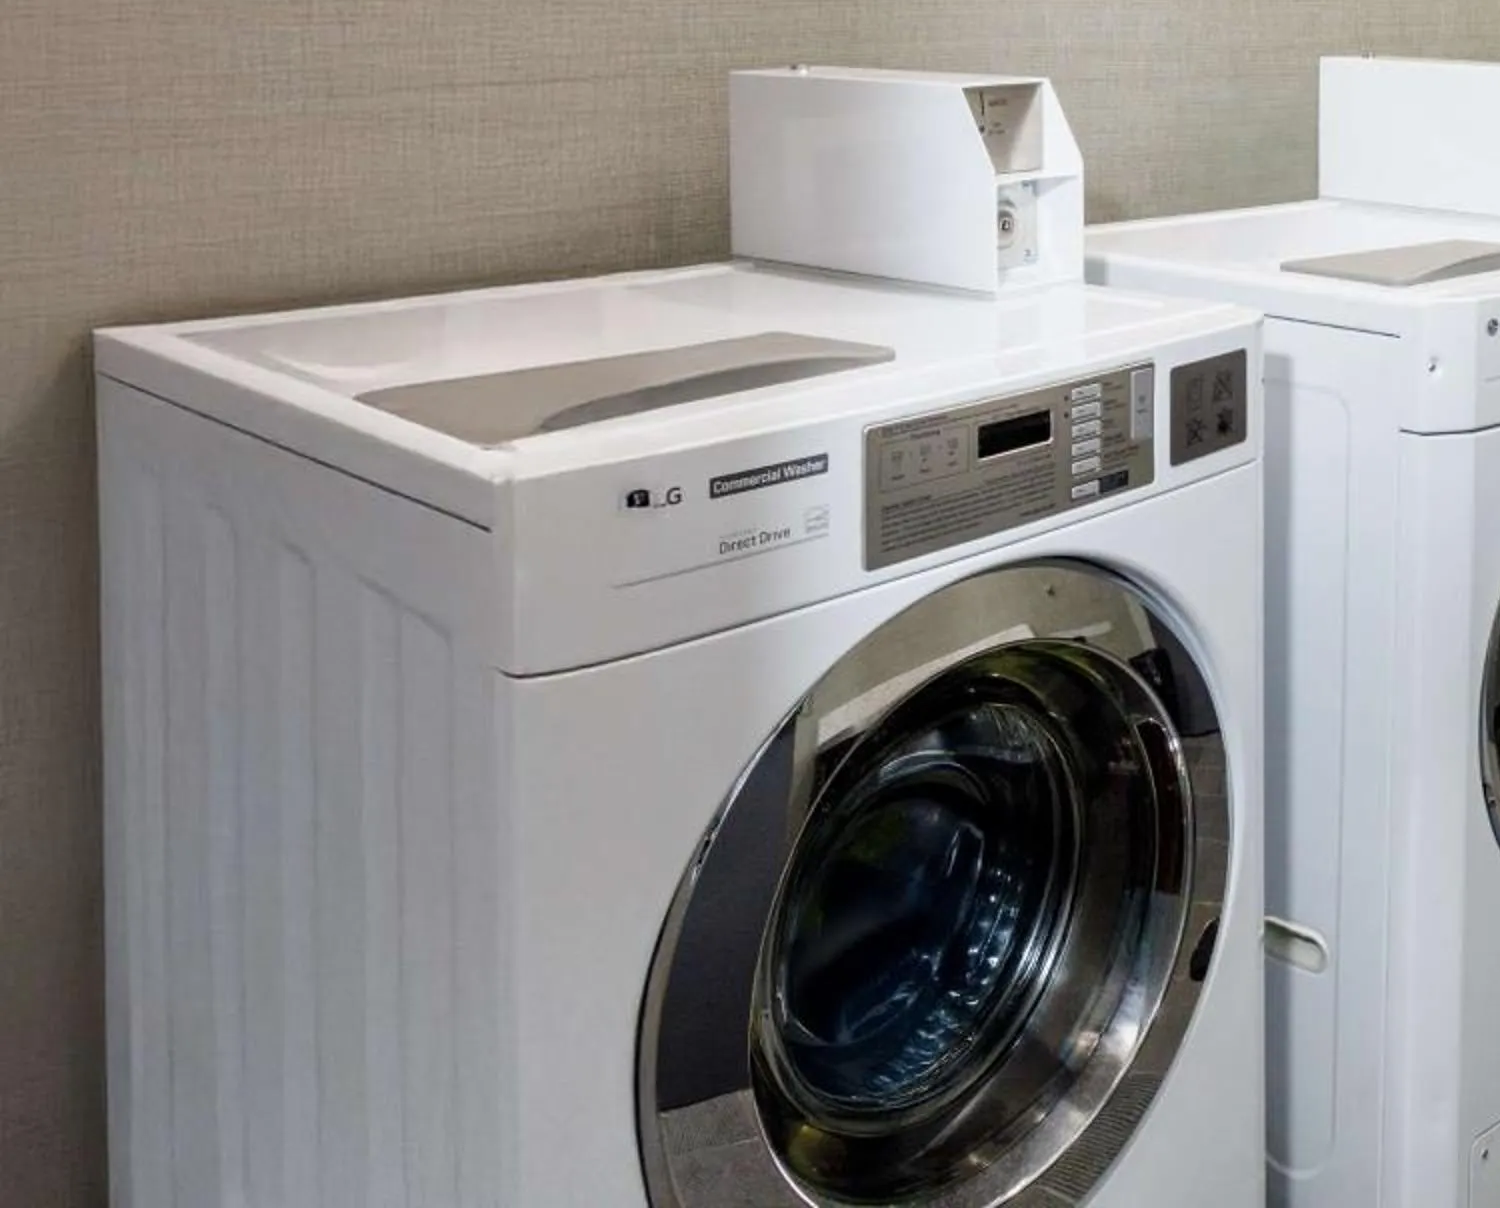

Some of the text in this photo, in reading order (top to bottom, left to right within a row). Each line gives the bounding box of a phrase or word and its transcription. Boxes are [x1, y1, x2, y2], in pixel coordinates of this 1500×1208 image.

[712, 459, 825, 494] Commercial Washer
[719, 534, 757, 555] Direct
[758, 527, 791, 545] Drive
